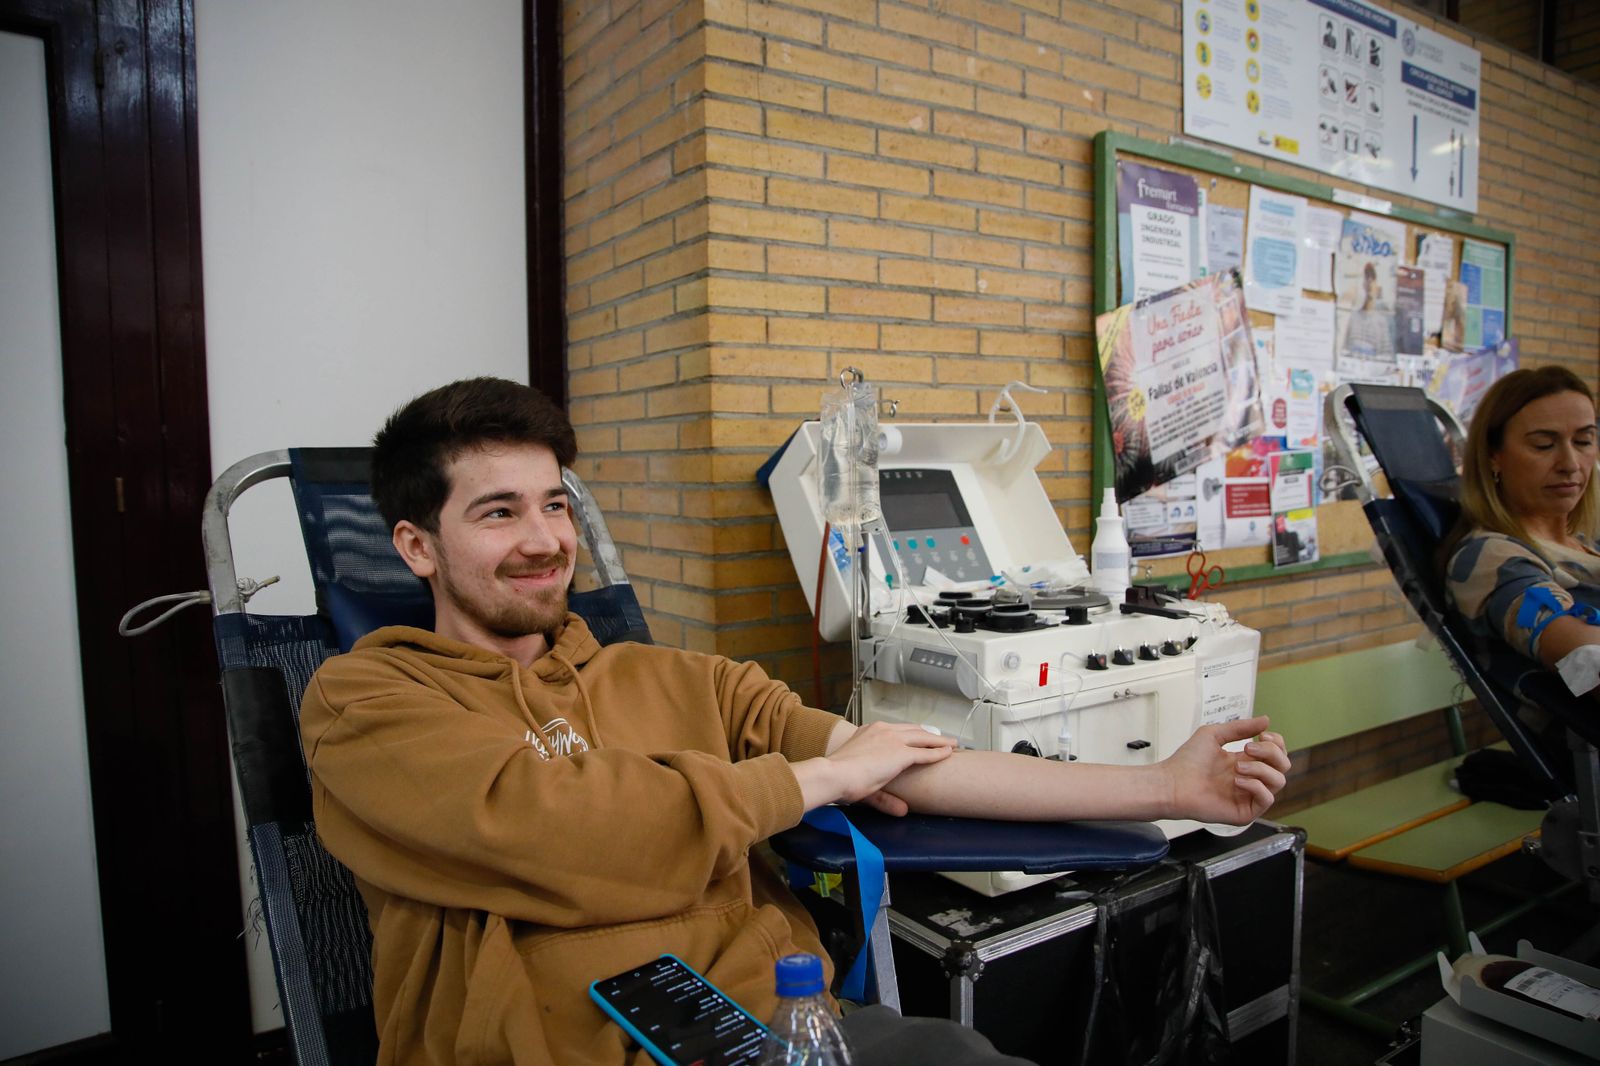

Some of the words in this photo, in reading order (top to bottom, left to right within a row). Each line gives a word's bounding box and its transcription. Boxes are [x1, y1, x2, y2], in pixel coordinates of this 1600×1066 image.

[1147, 211, 1175, 225] GRADO
[1141, 235, 1181, 248] INDUSTRIAL
[1148, 381, 1173, 400] Fallas
[1174, 375, 1184, 390] de
[1185, 362, 1218, 384] Valencia
